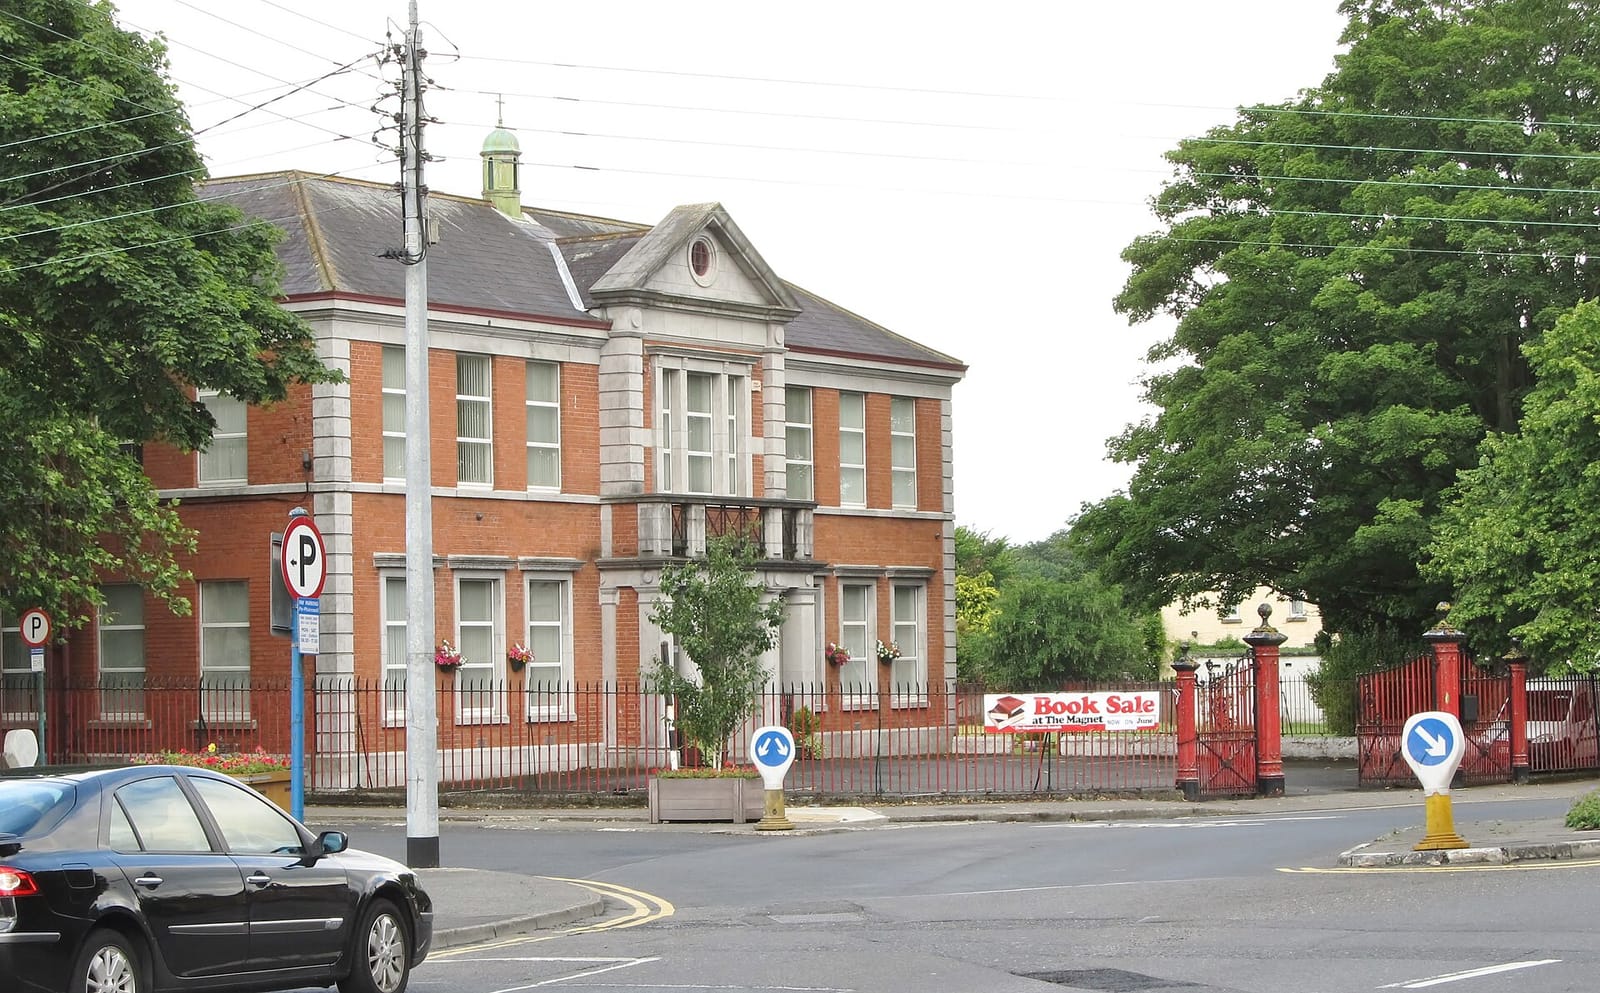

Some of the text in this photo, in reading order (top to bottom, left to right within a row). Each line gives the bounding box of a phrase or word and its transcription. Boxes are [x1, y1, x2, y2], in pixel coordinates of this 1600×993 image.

[300, 535, 316, 587] P
[32, 617, 41, 638] P
[1034, 695, 1155, 715] Book Sale
[1045, 715, 1065, 724] The
[1066, 715, 1104, 725] Magnet
